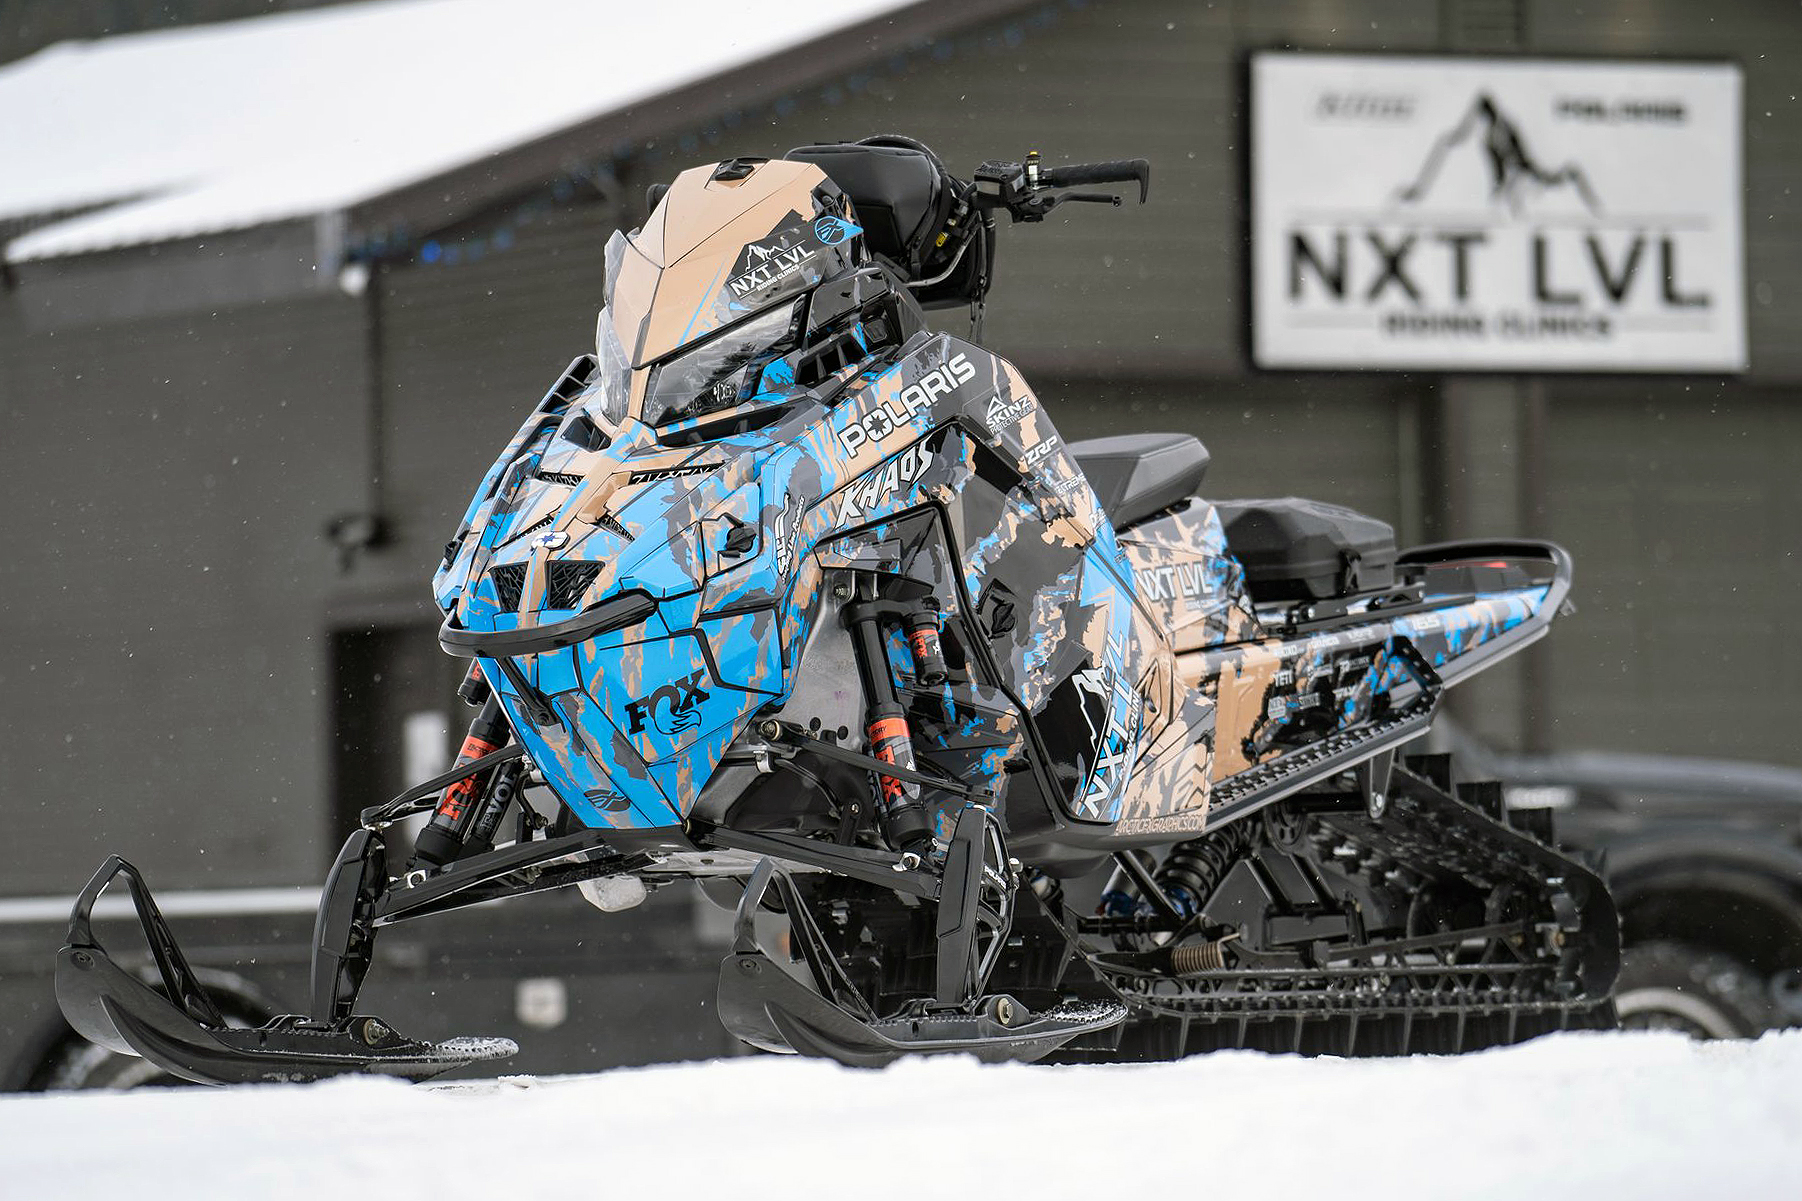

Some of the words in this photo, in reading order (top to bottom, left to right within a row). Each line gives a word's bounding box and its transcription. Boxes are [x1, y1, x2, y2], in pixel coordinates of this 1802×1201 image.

[731, 264, 772, 296] NXT
[774, 246, 815, 271] LVL
[756, 276, 778, 292] RIDING
[777, 264, 800, 280] CLINICS
[1288, 233, 1488, 303] NXT
[1533, 235, 1711, 307] LVL
[838, 353, 976, 458] POLARIS
[986, 396, 1031, 429] SKINZ
[1025, 435, 1058, 465] ZRP
[834, 433, 934, 530] KHAOS
[1135, 566, 1176, 601] NXT
[1176, 562, 1213, 598] LVL
[624, 668, 710, 735] FOX
[1274, 669, 1293, 687] YETI
[1085, 707, 1129, 819] NXT
